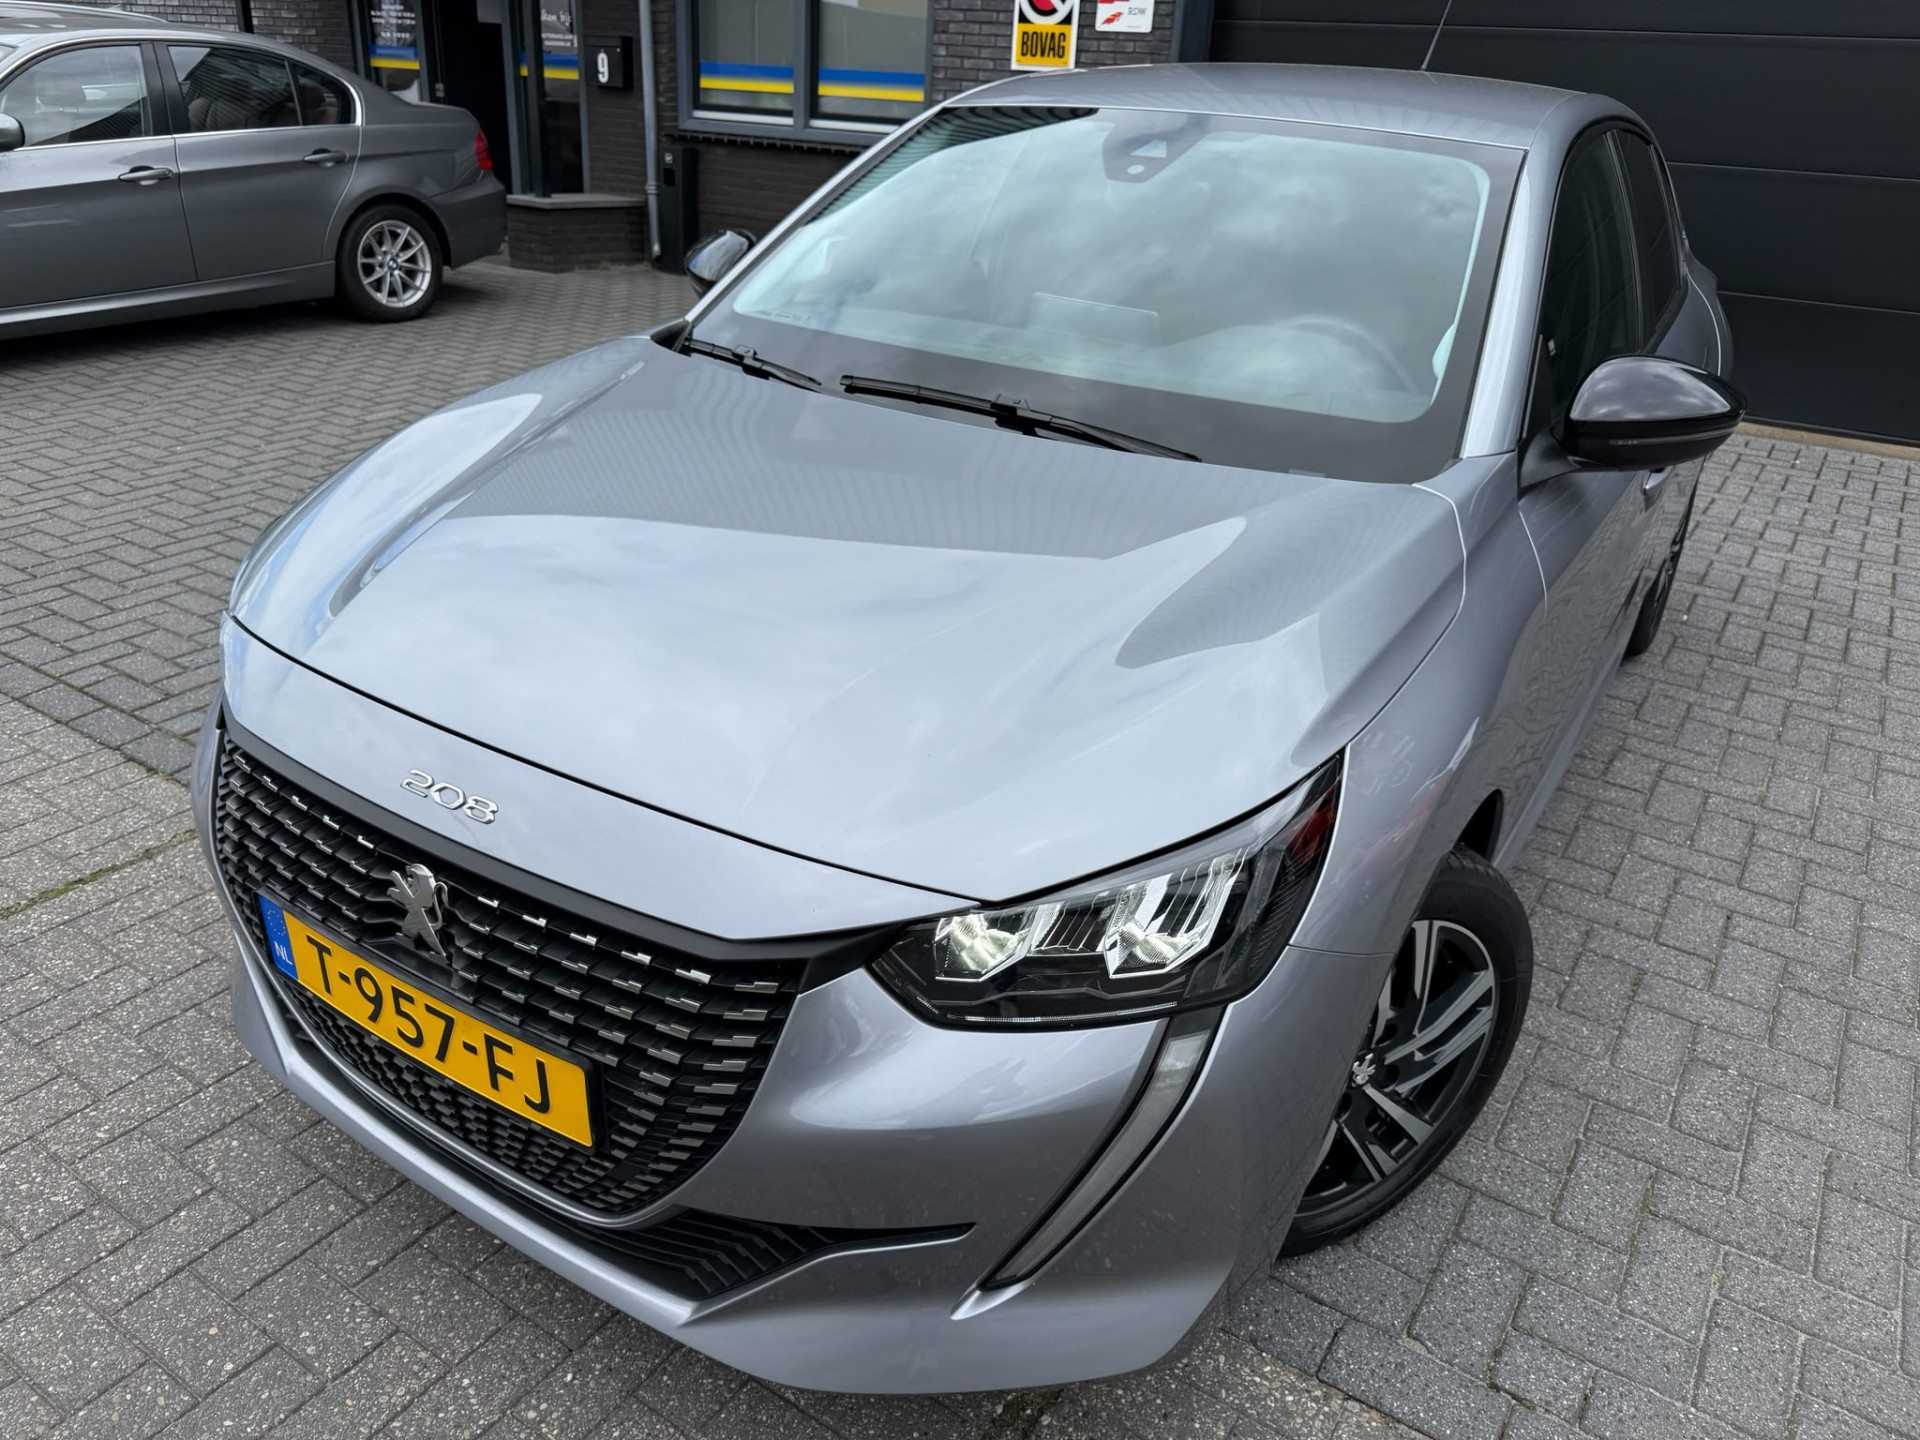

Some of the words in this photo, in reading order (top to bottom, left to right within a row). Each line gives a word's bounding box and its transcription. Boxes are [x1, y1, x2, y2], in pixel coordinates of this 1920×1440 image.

[1021, 31, 1066, 59] BOVAG
[597, 52, 609, 83] 9
[400, 769, 499, 824] 208
[274, 940, 293, 966] NL
[306, 934, 551, 1114] T-957-FJ
